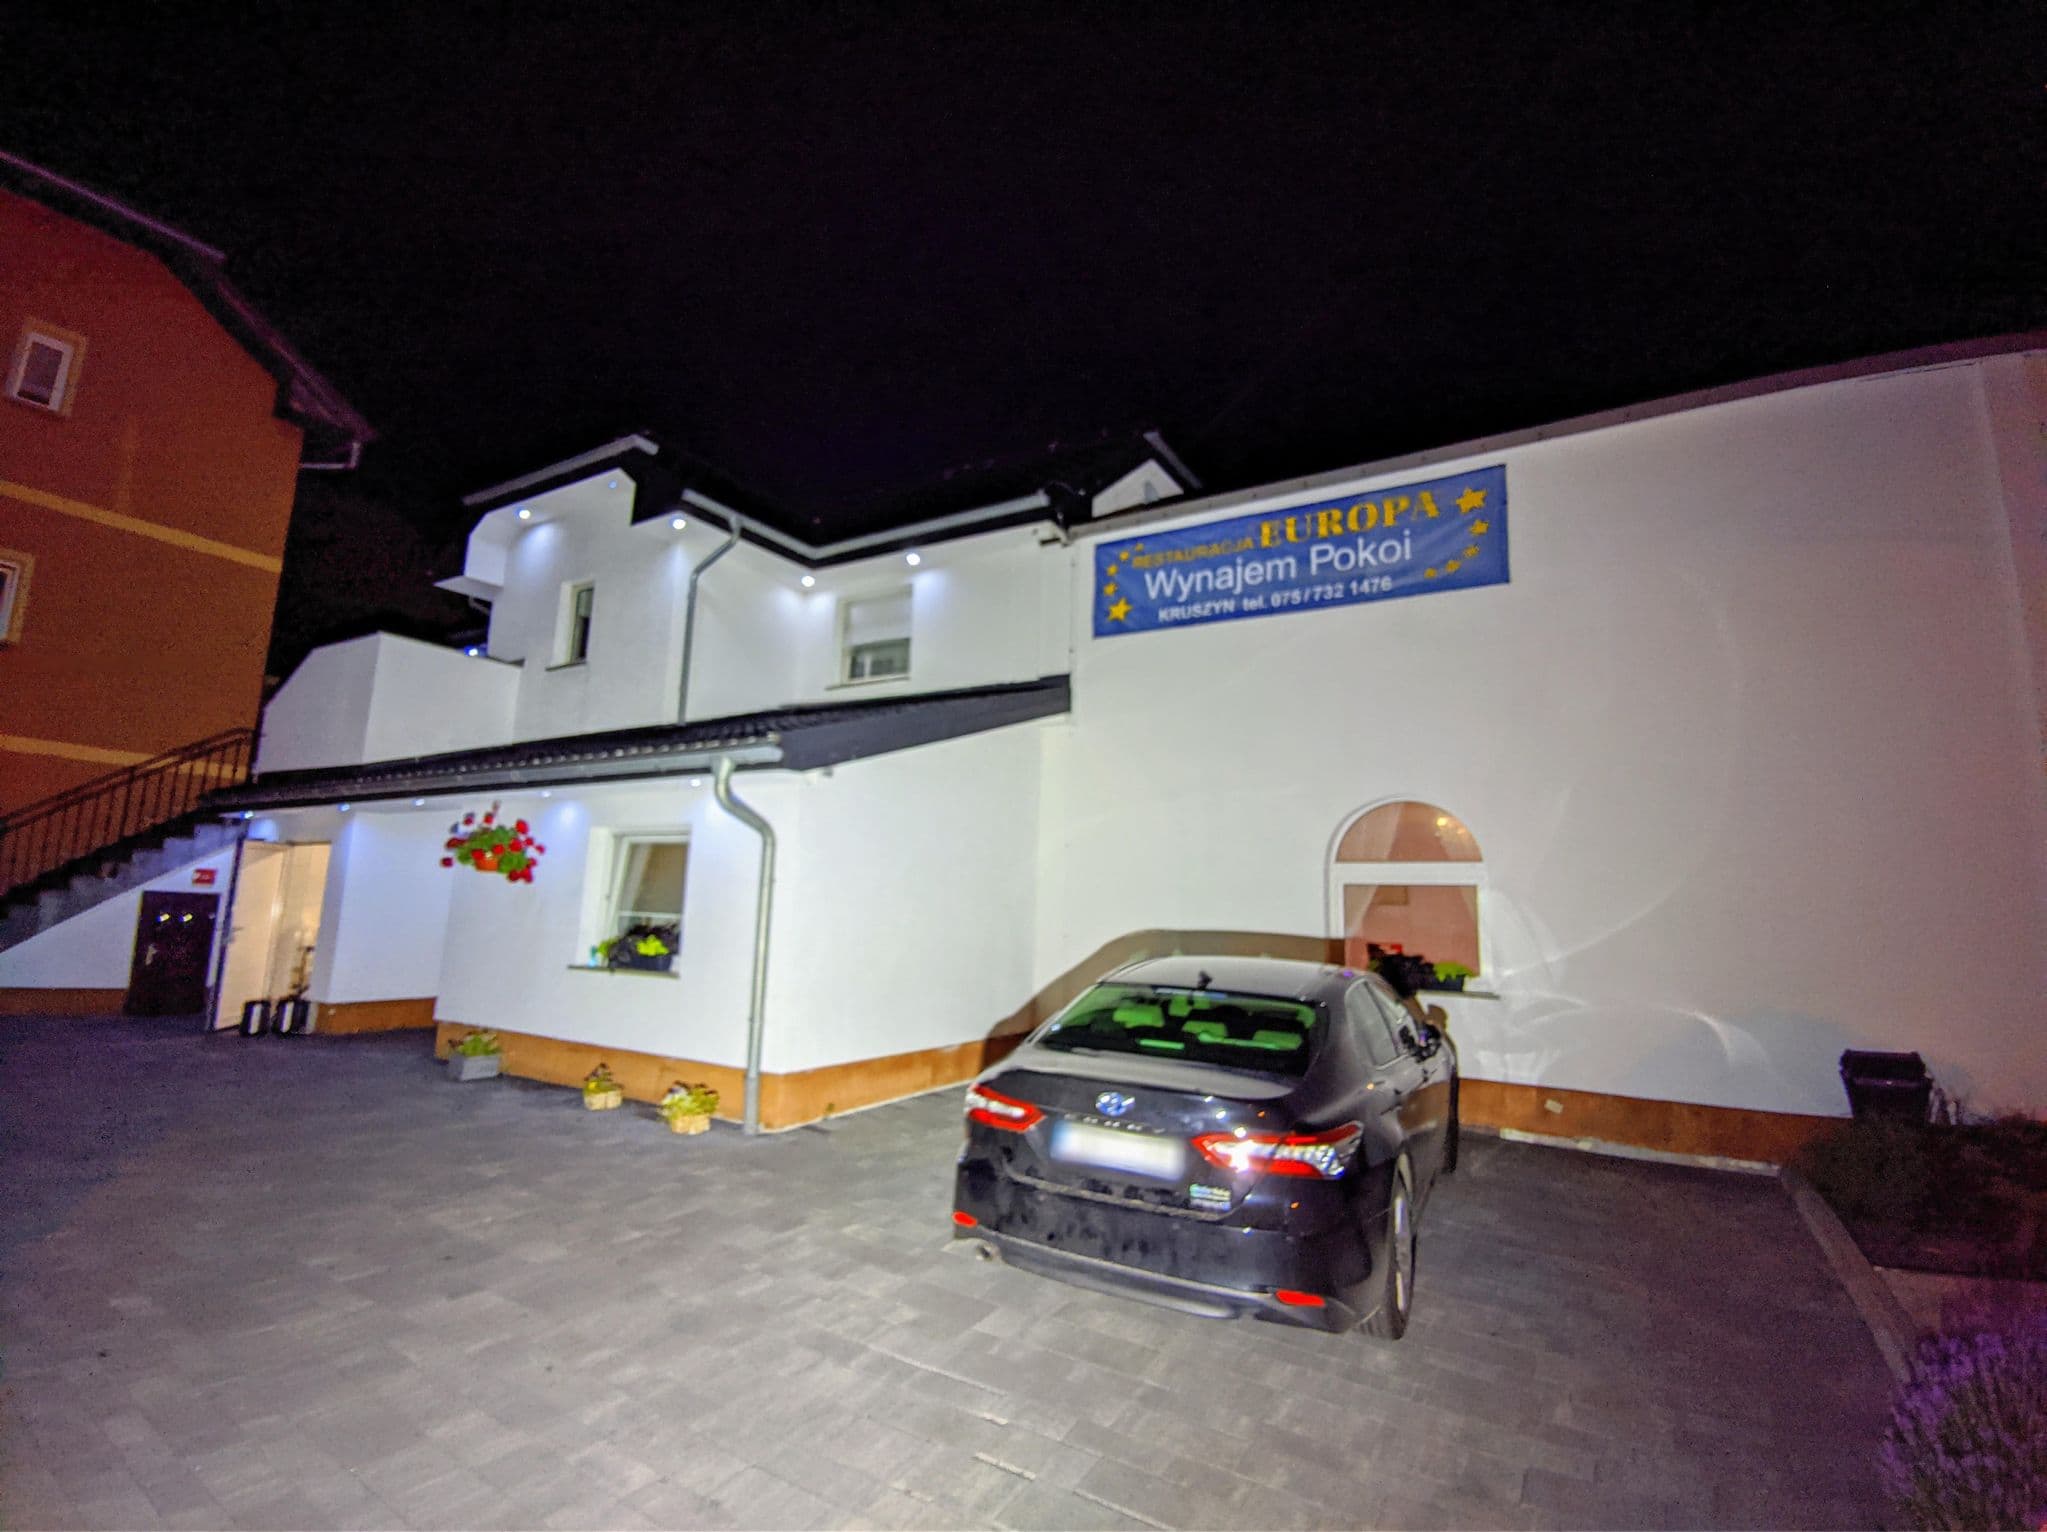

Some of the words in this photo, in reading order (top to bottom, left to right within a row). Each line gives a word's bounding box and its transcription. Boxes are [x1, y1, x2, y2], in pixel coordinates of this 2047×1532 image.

[1260, 490, 1440, 548] EUROPA
[1144, 555, 1297, 602] Wynajem
[1309, 528, 1412, 576] Pokoi
[1157, 598, 1236, 623] KRUSZYN
[1242, 595, 1267, 612] tel.
[1350, 576, 1393, 596] 1476
